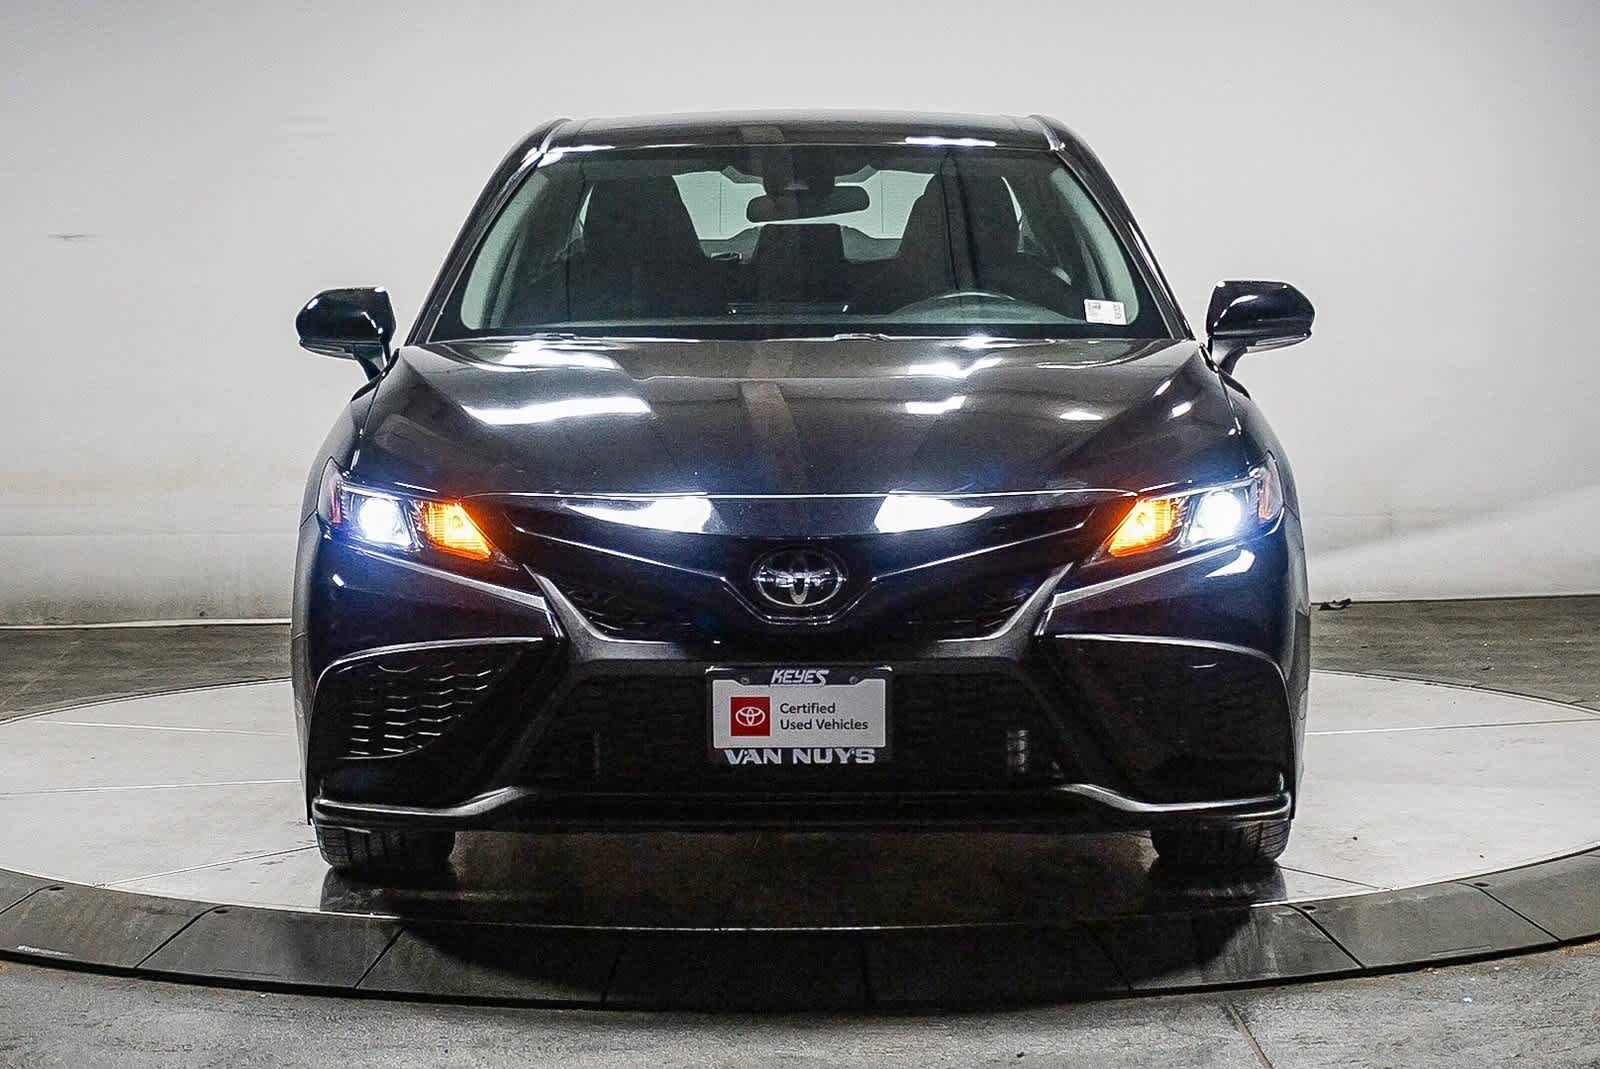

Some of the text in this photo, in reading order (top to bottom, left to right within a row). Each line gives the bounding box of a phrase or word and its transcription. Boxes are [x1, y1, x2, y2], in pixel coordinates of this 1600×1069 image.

[770, 669, 830, 686] KEYES
[780, 702, 836, 714] Certified
[780, 718, 868, 730] Used Vehicles
[724, 749, 876, 765] VAN NUYS
